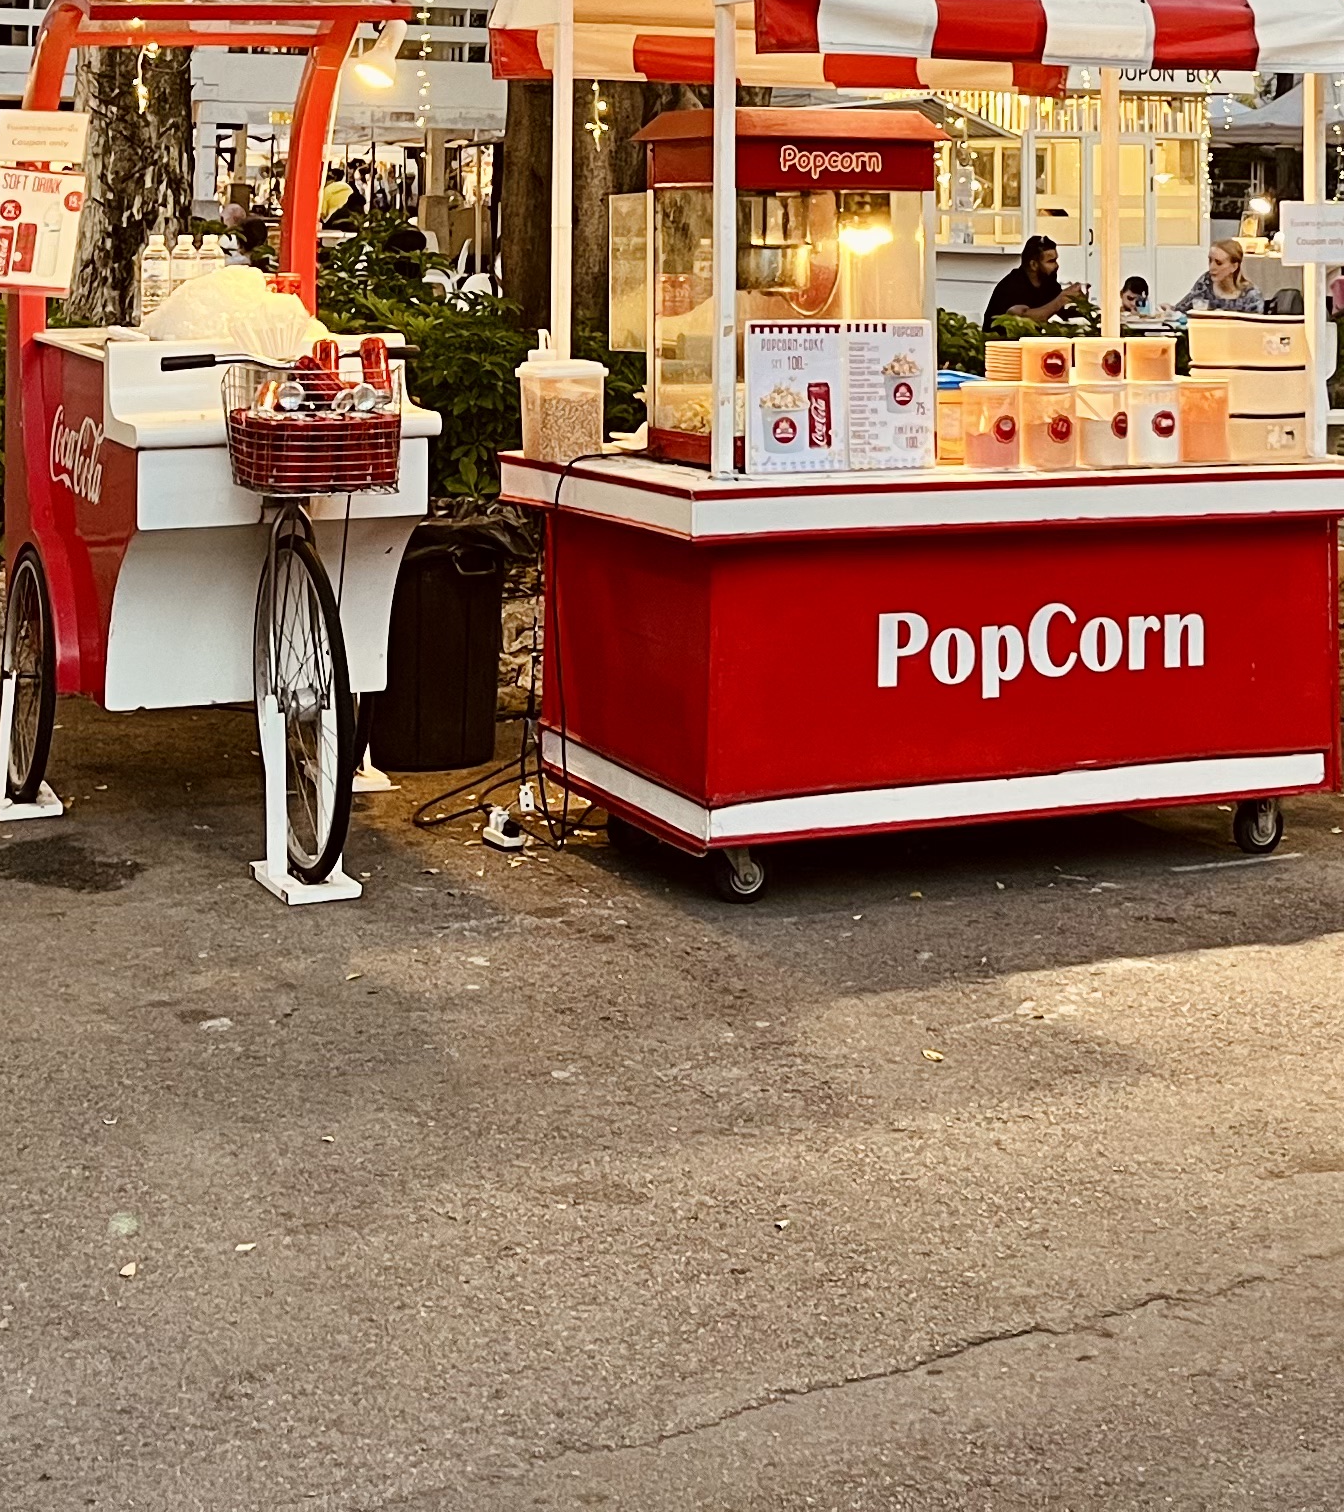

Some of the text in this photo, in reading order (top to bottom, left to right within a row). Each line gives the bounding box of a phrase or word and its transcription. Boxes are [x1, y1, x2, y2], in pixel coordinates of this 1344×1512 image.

[1099, 68, 1222, 83] UPON BOX
[779, 145, 882, 179] Popcorn
[2, 173, 63, 194] SOFT DRINK
[49, 404, 106, 505] Coca-Cola
[877, 602, 1205, 699] PopCorn
